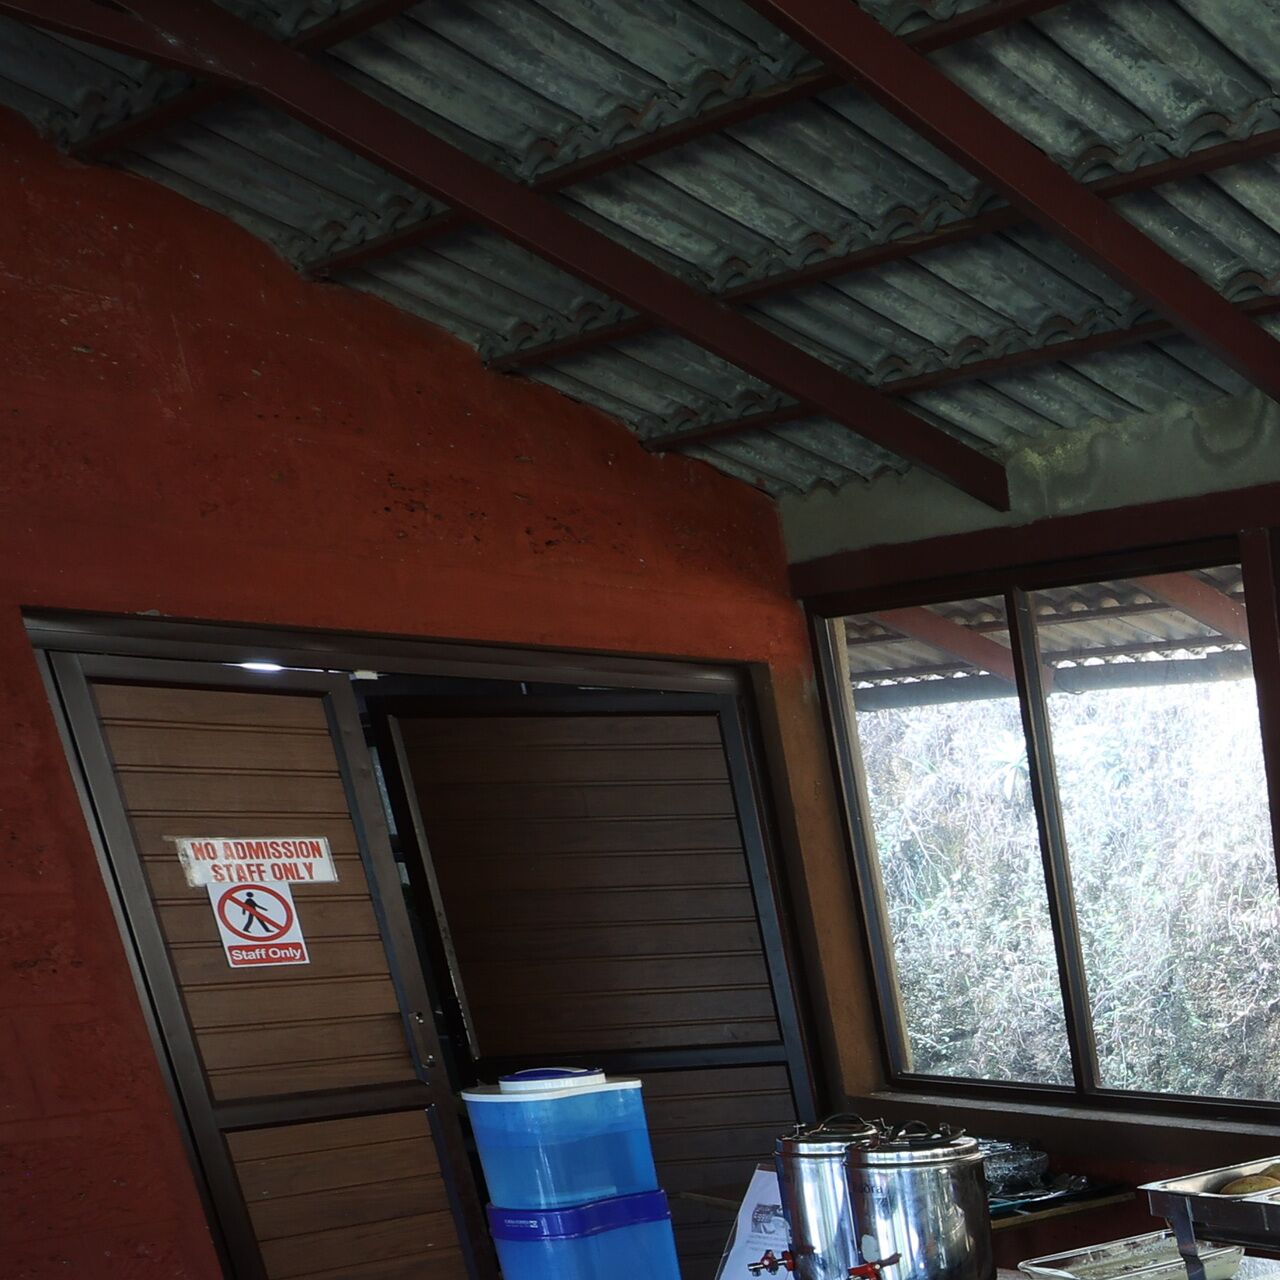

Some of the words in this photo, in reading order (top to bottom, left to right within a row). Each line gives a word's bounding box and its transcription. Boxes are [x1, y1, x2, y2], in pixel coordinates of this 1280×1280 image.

[191, 842, 218, 860] NO
[222, 840, 323, 860] ADMISSION
[211, 863, 266, 882] STAFF
[270, 862, 314, 881] ONLY
[231, 948, 266, 961] Staff
[268, 946, 302, 960] Only
